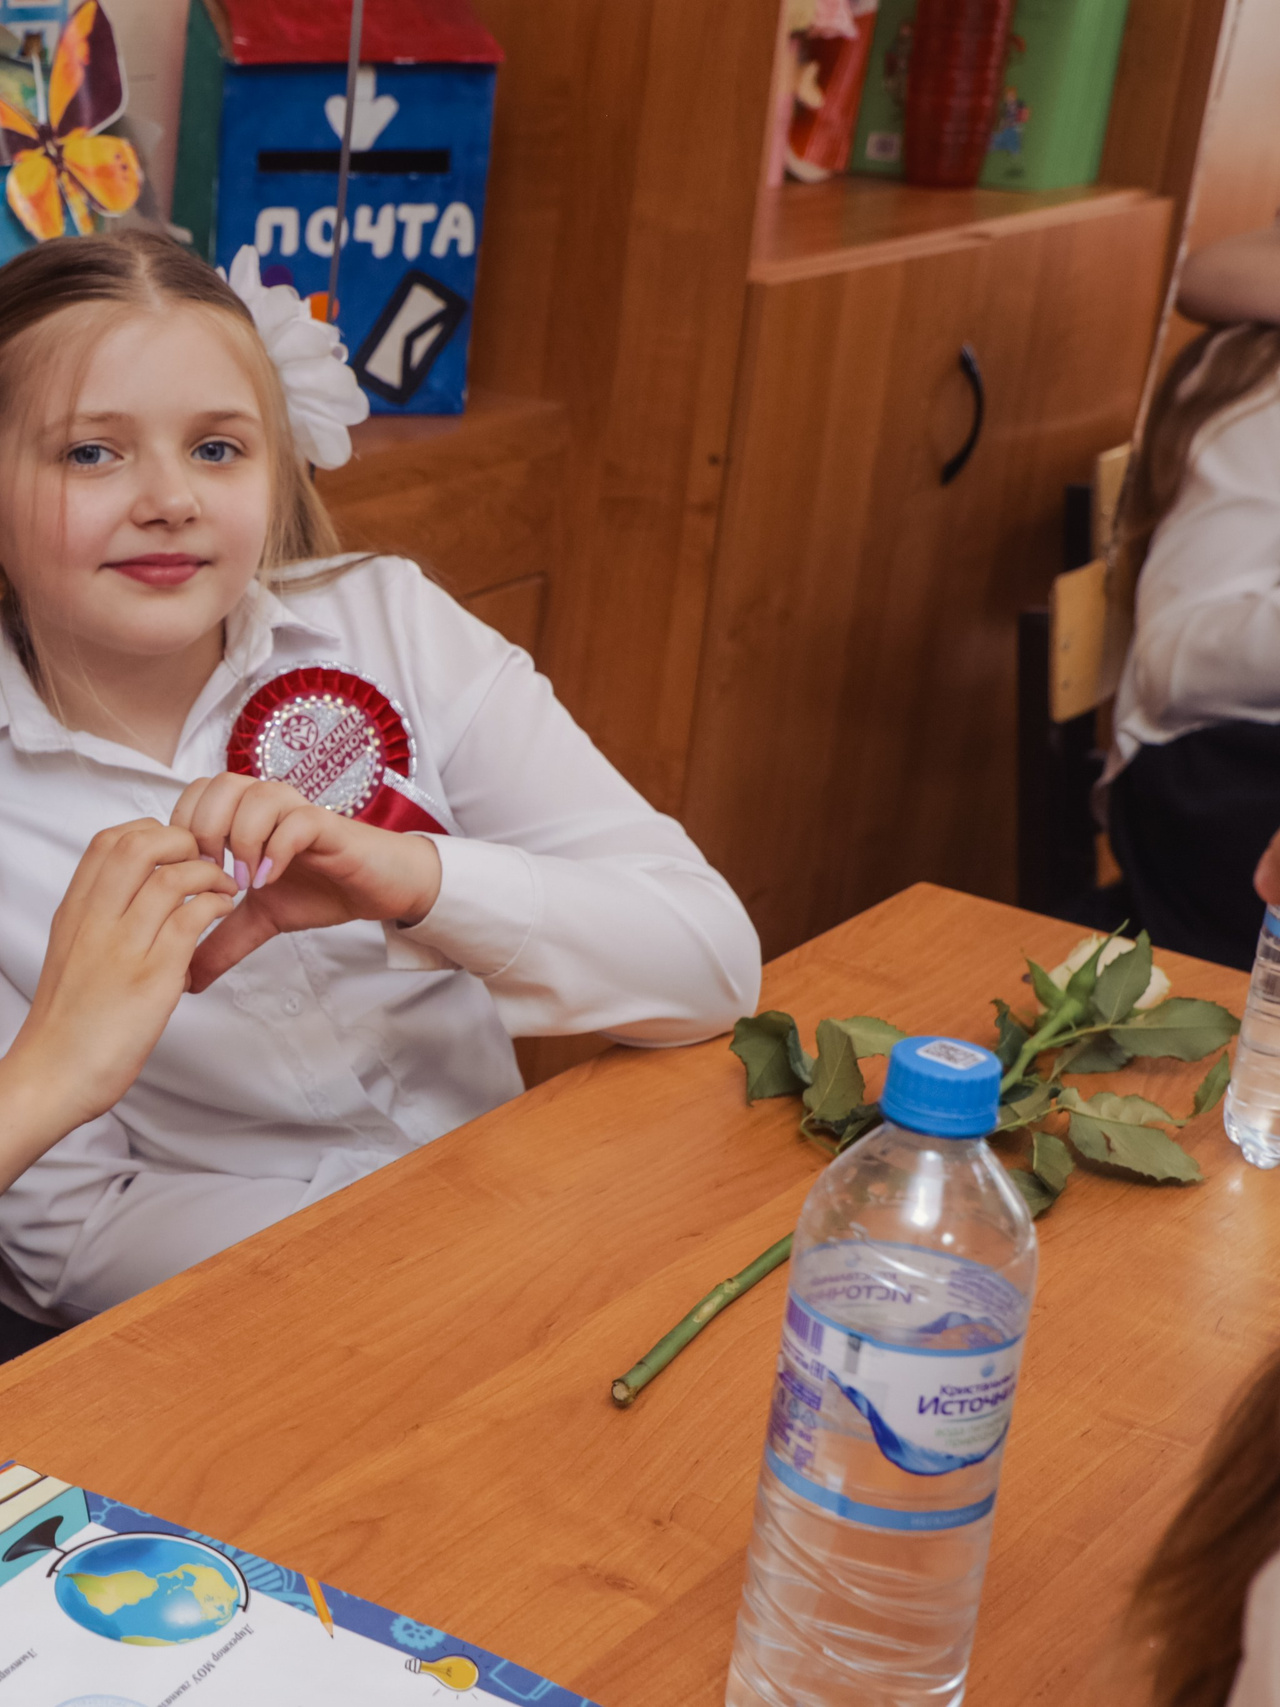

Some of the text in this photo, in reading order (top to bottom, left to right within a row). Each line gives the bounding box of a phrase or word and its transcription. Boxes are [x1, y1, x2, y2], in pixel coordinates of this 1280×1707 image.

[255, 202, 475, 260] ПОЧТА
[285, 710, 366, 788] ыпускник
[297, 726, 369, 796] ачальной
[211, 1623, 255, 1663] Директор
[191, 1660, 216, 1685] МОУ
